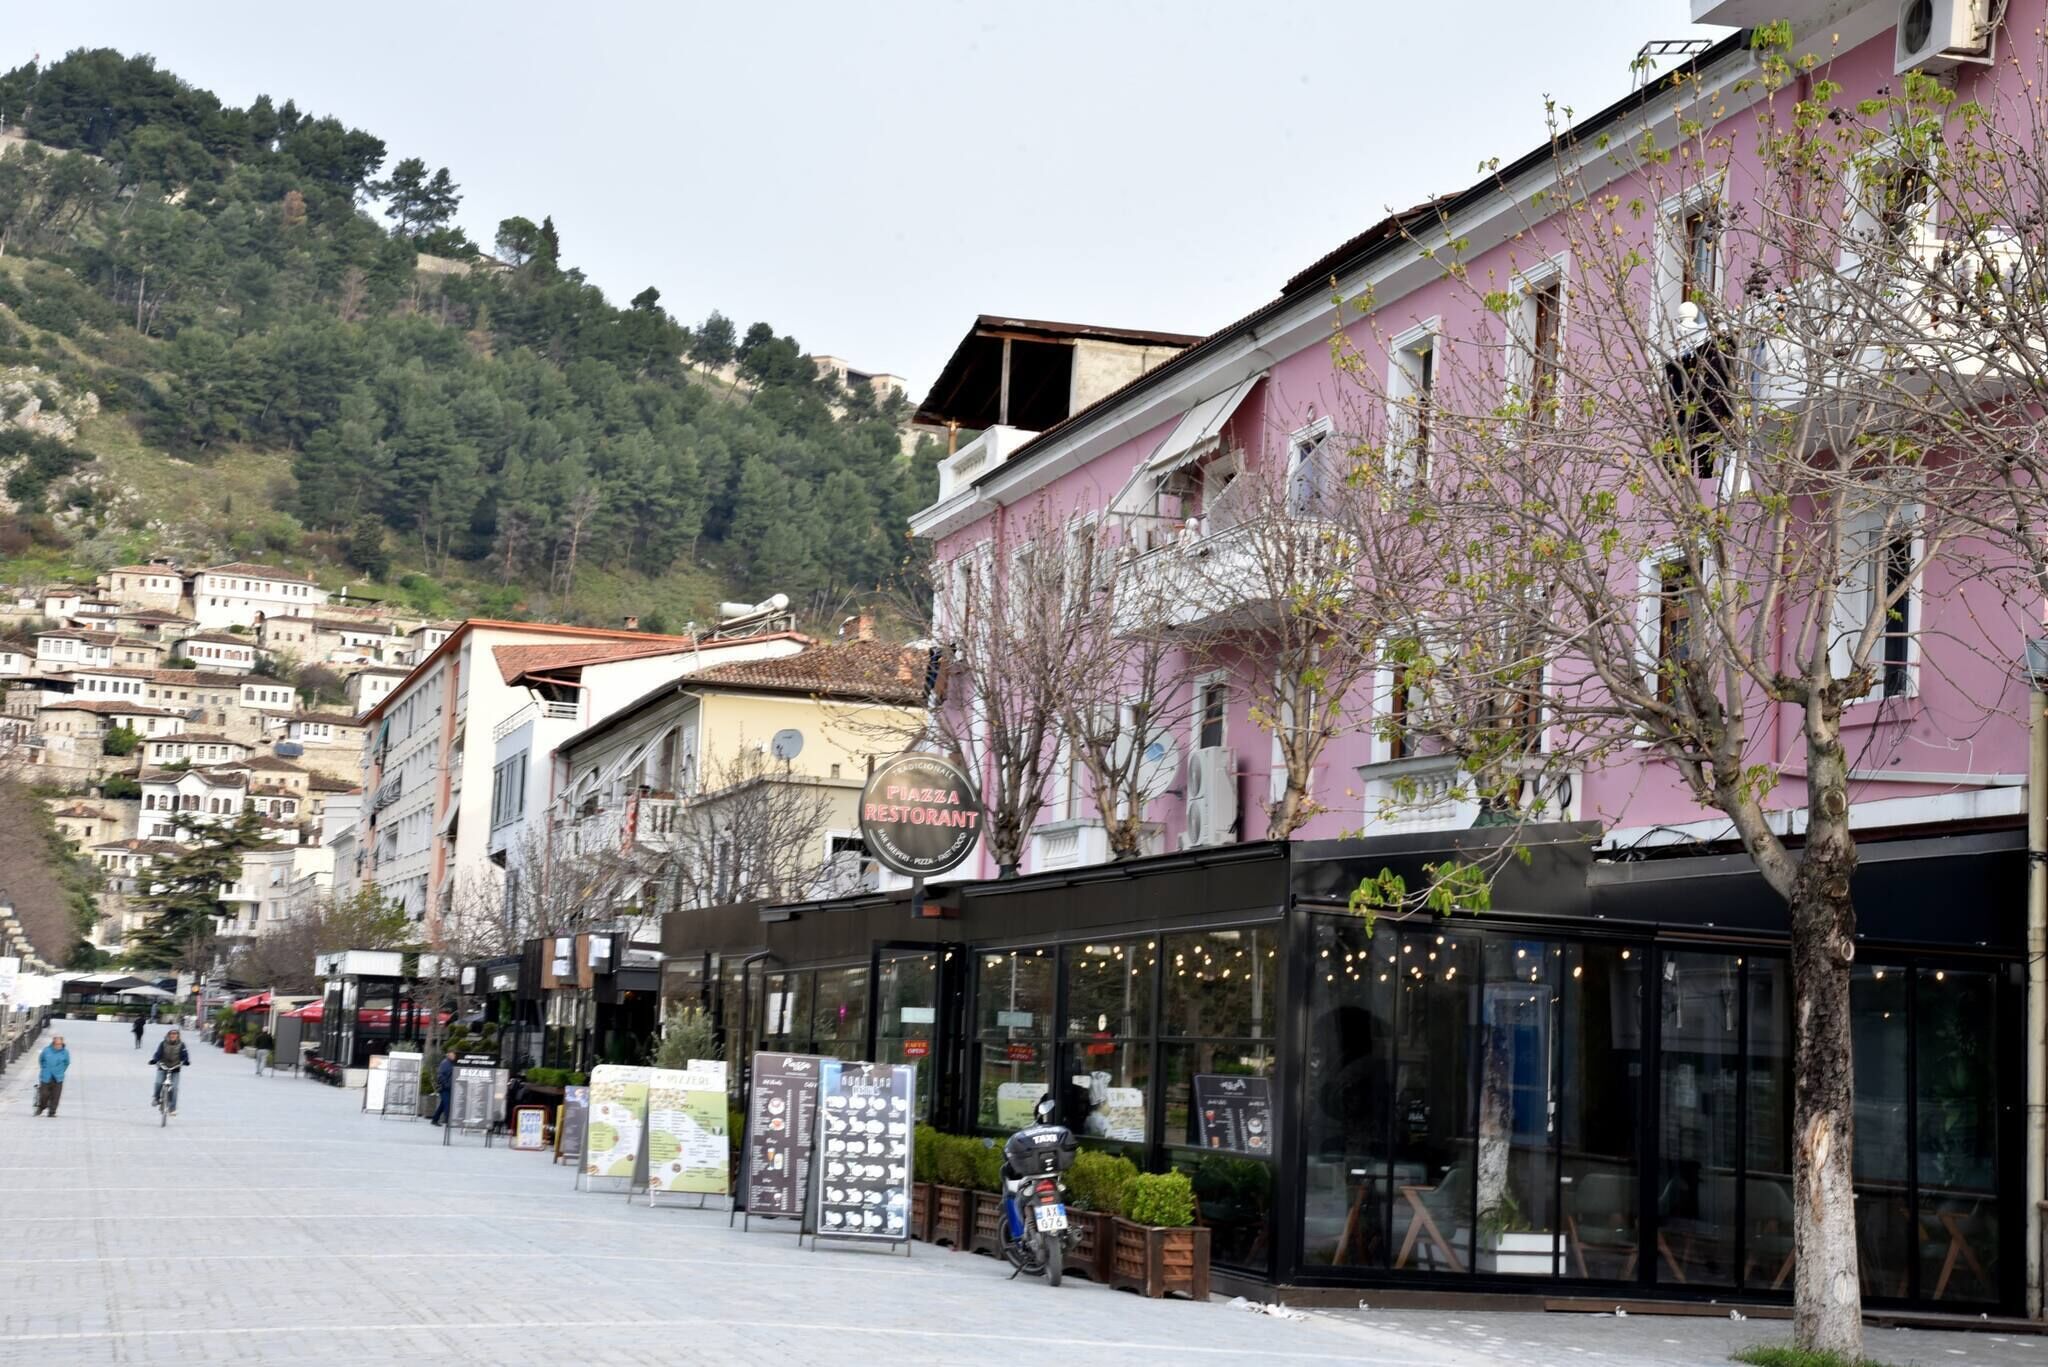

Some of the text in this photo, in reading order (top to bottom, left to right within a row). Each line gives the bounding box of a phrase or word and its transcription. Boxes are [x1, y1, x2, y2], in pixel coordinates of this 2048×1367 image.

[886, 785, 960, 804] PIAZZA
[864, 803, 979, 828] RESTORANT
[913, 857, 934, 865] PIZZA
[1032, 1133, 1058, 1145] TAXI
